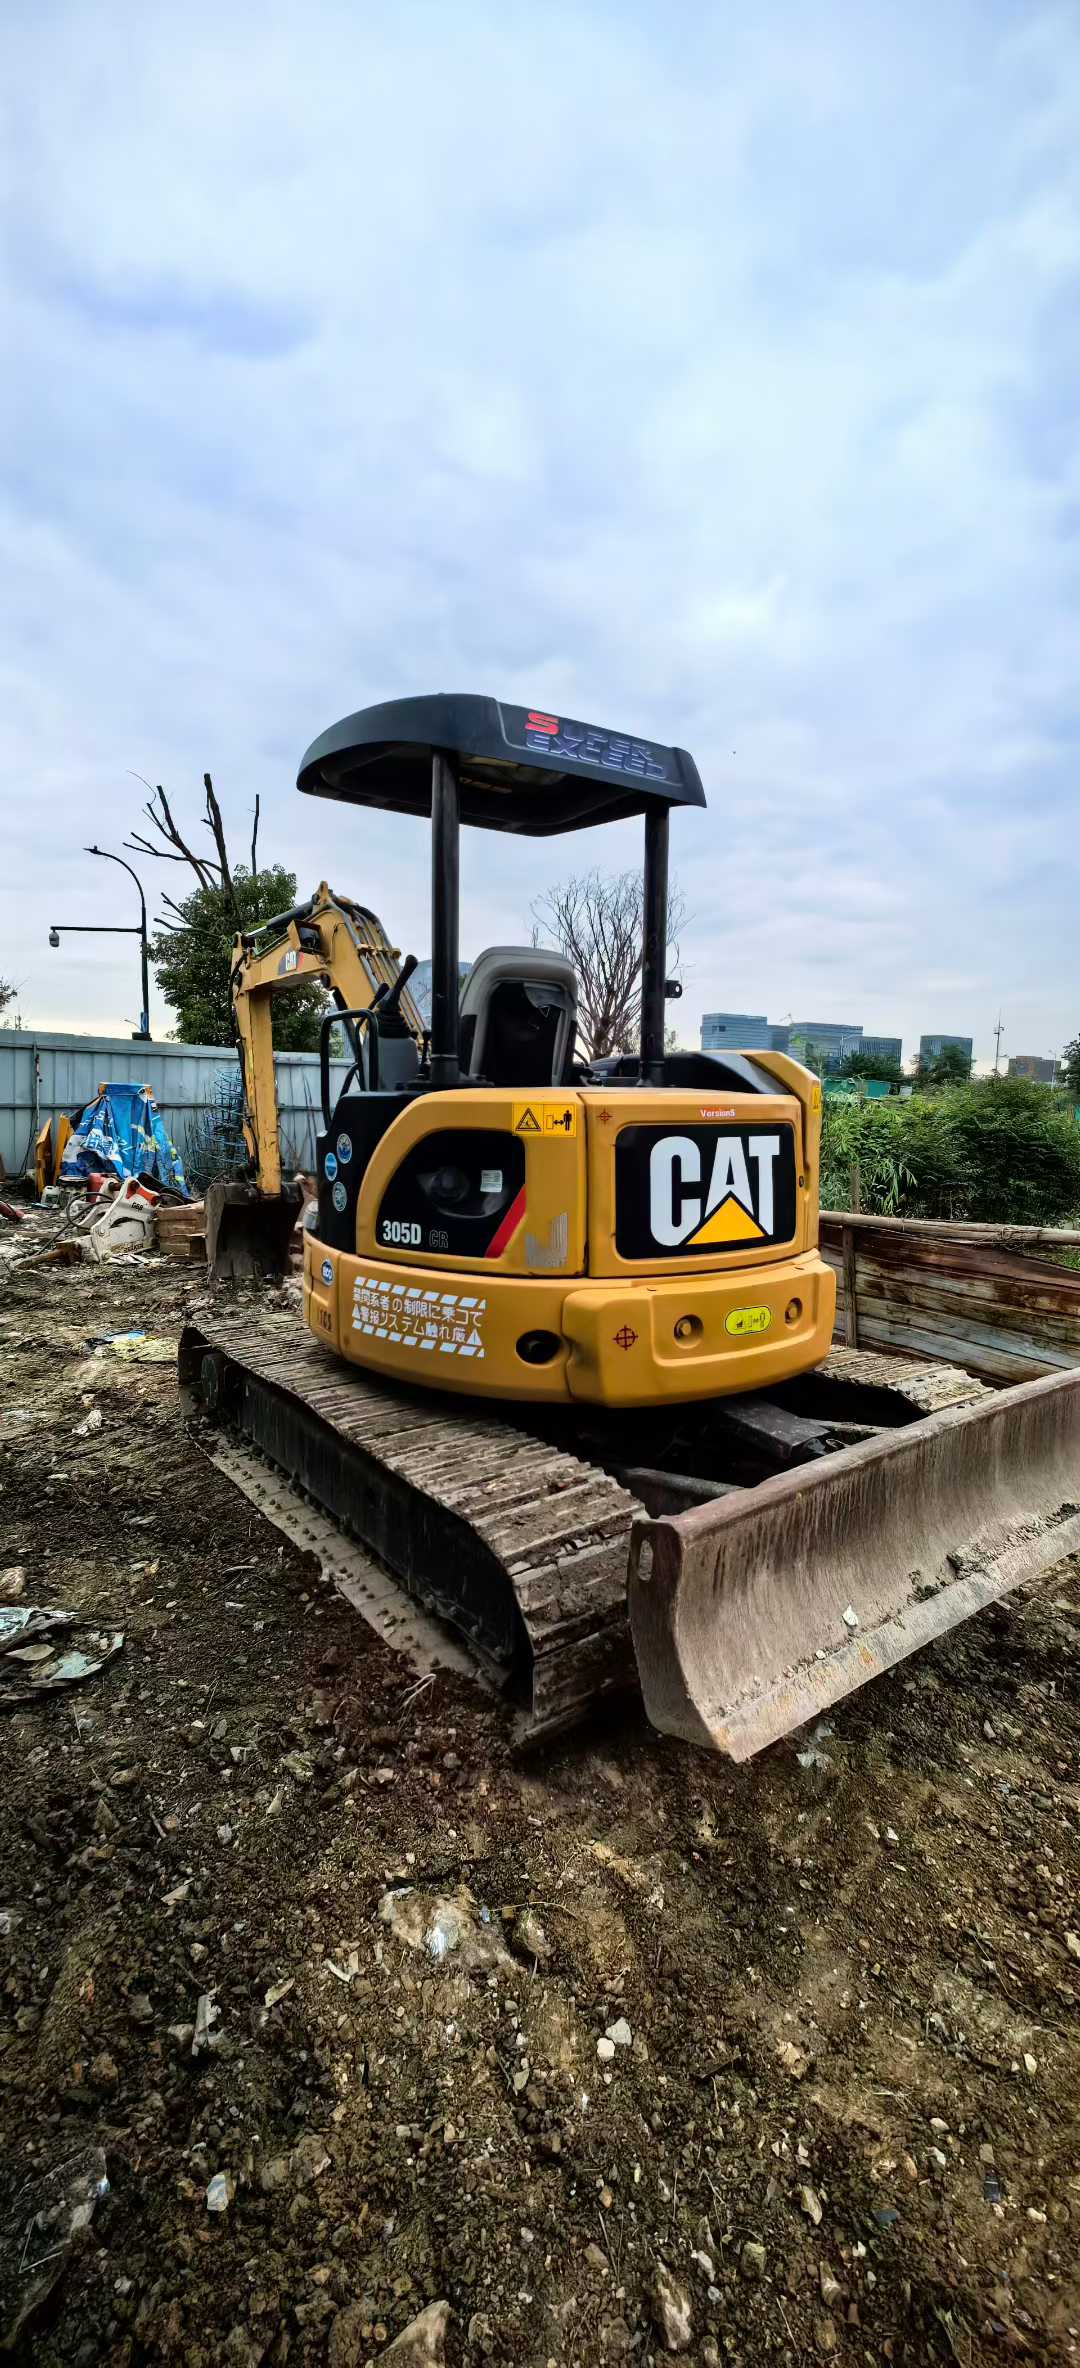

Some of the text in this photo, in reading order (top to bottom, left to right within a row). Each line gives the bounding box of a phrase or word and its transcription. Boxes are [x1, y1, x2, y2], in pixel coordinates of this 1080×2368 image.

[526, 732, 666, 779] EXCEED
[650, 1135, 780, 1247] CAT
[382, 1220, 449, 1249] 305D CR
